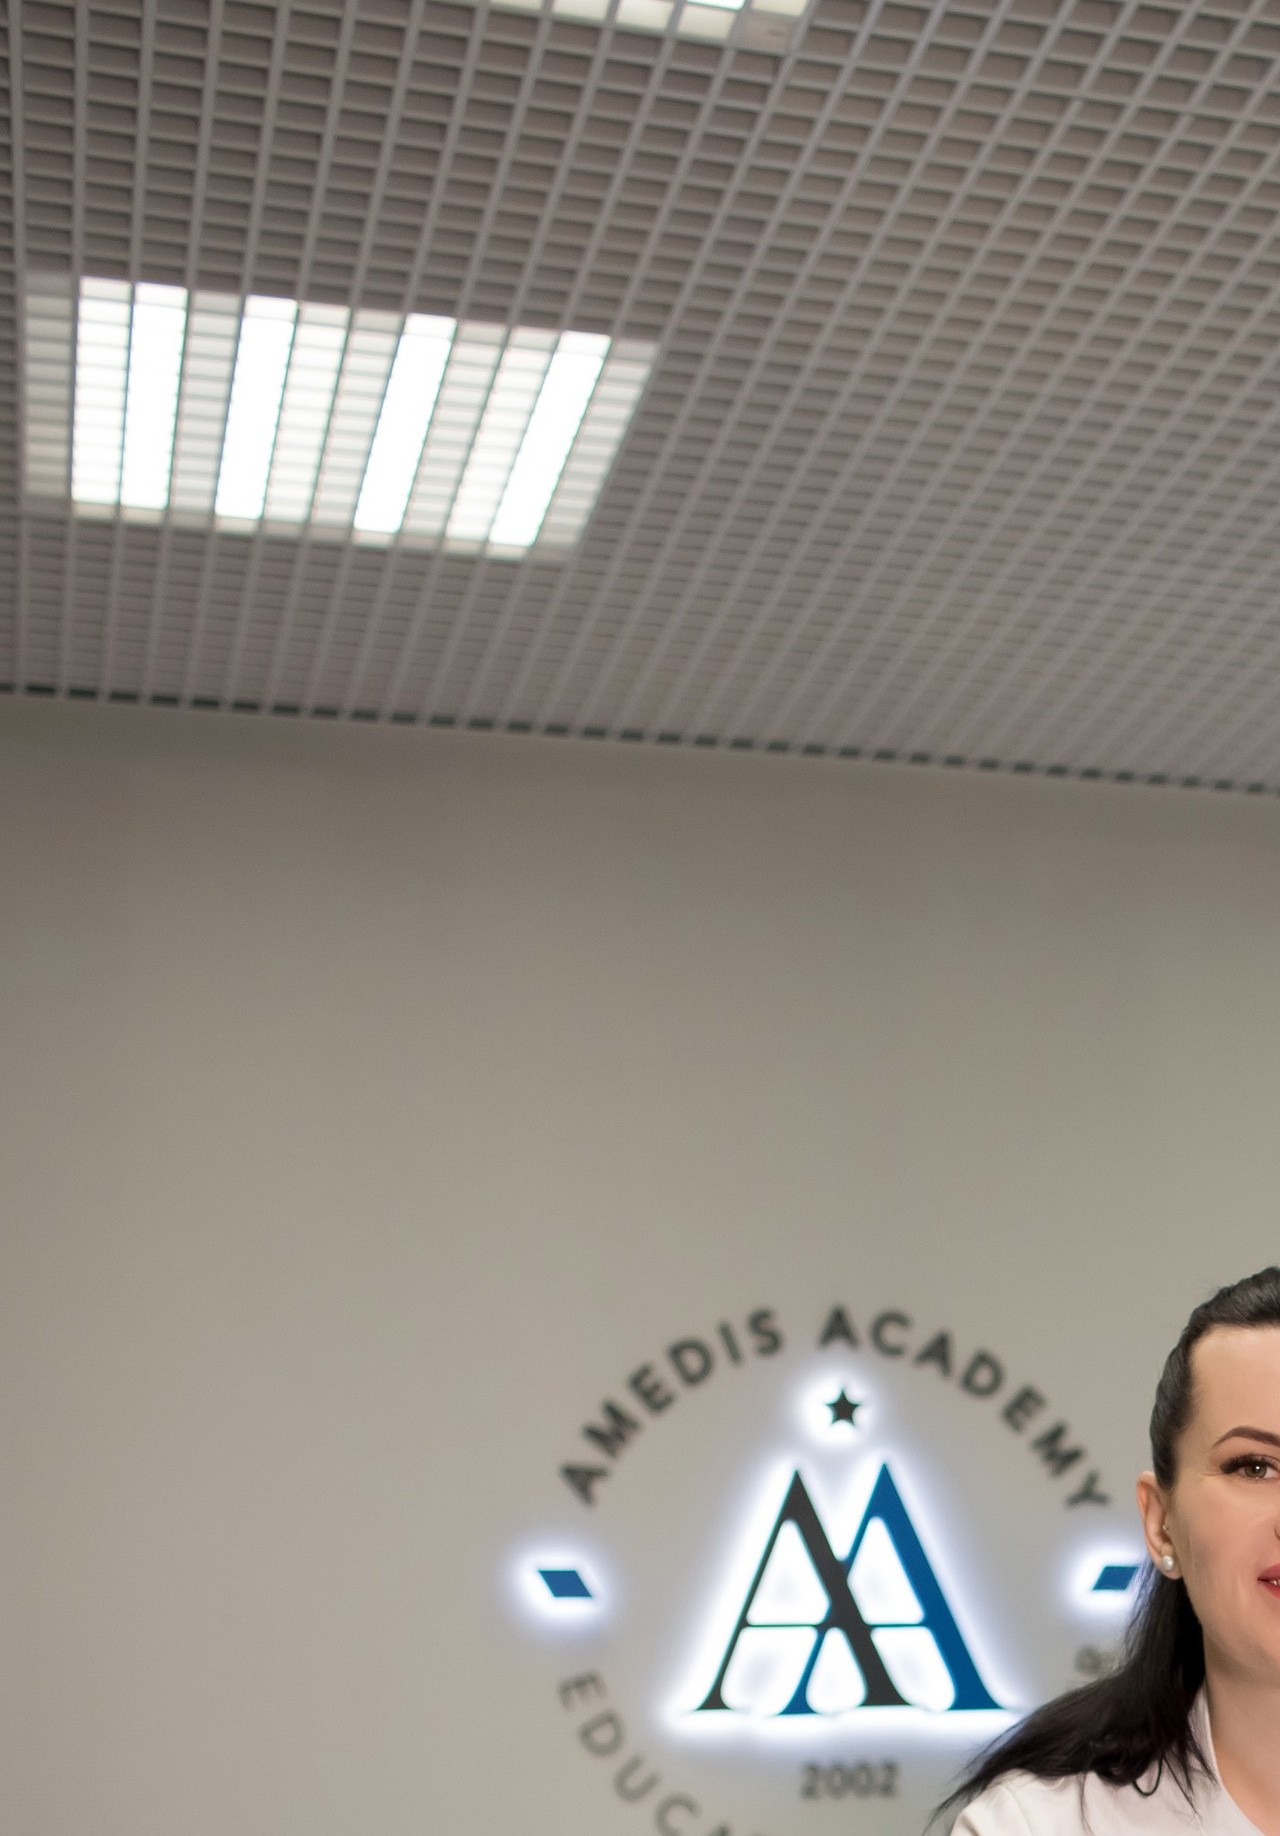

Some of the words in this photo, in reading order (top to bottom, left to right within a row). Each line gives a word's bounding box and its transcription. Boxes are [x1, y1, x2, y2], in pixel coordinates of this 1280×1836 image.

[560, 1308, 785, 1505] AMEDIS
[819, 1305, 1109, 1511] ACADEMY
[803, 1762, 898, 1799] 2002
